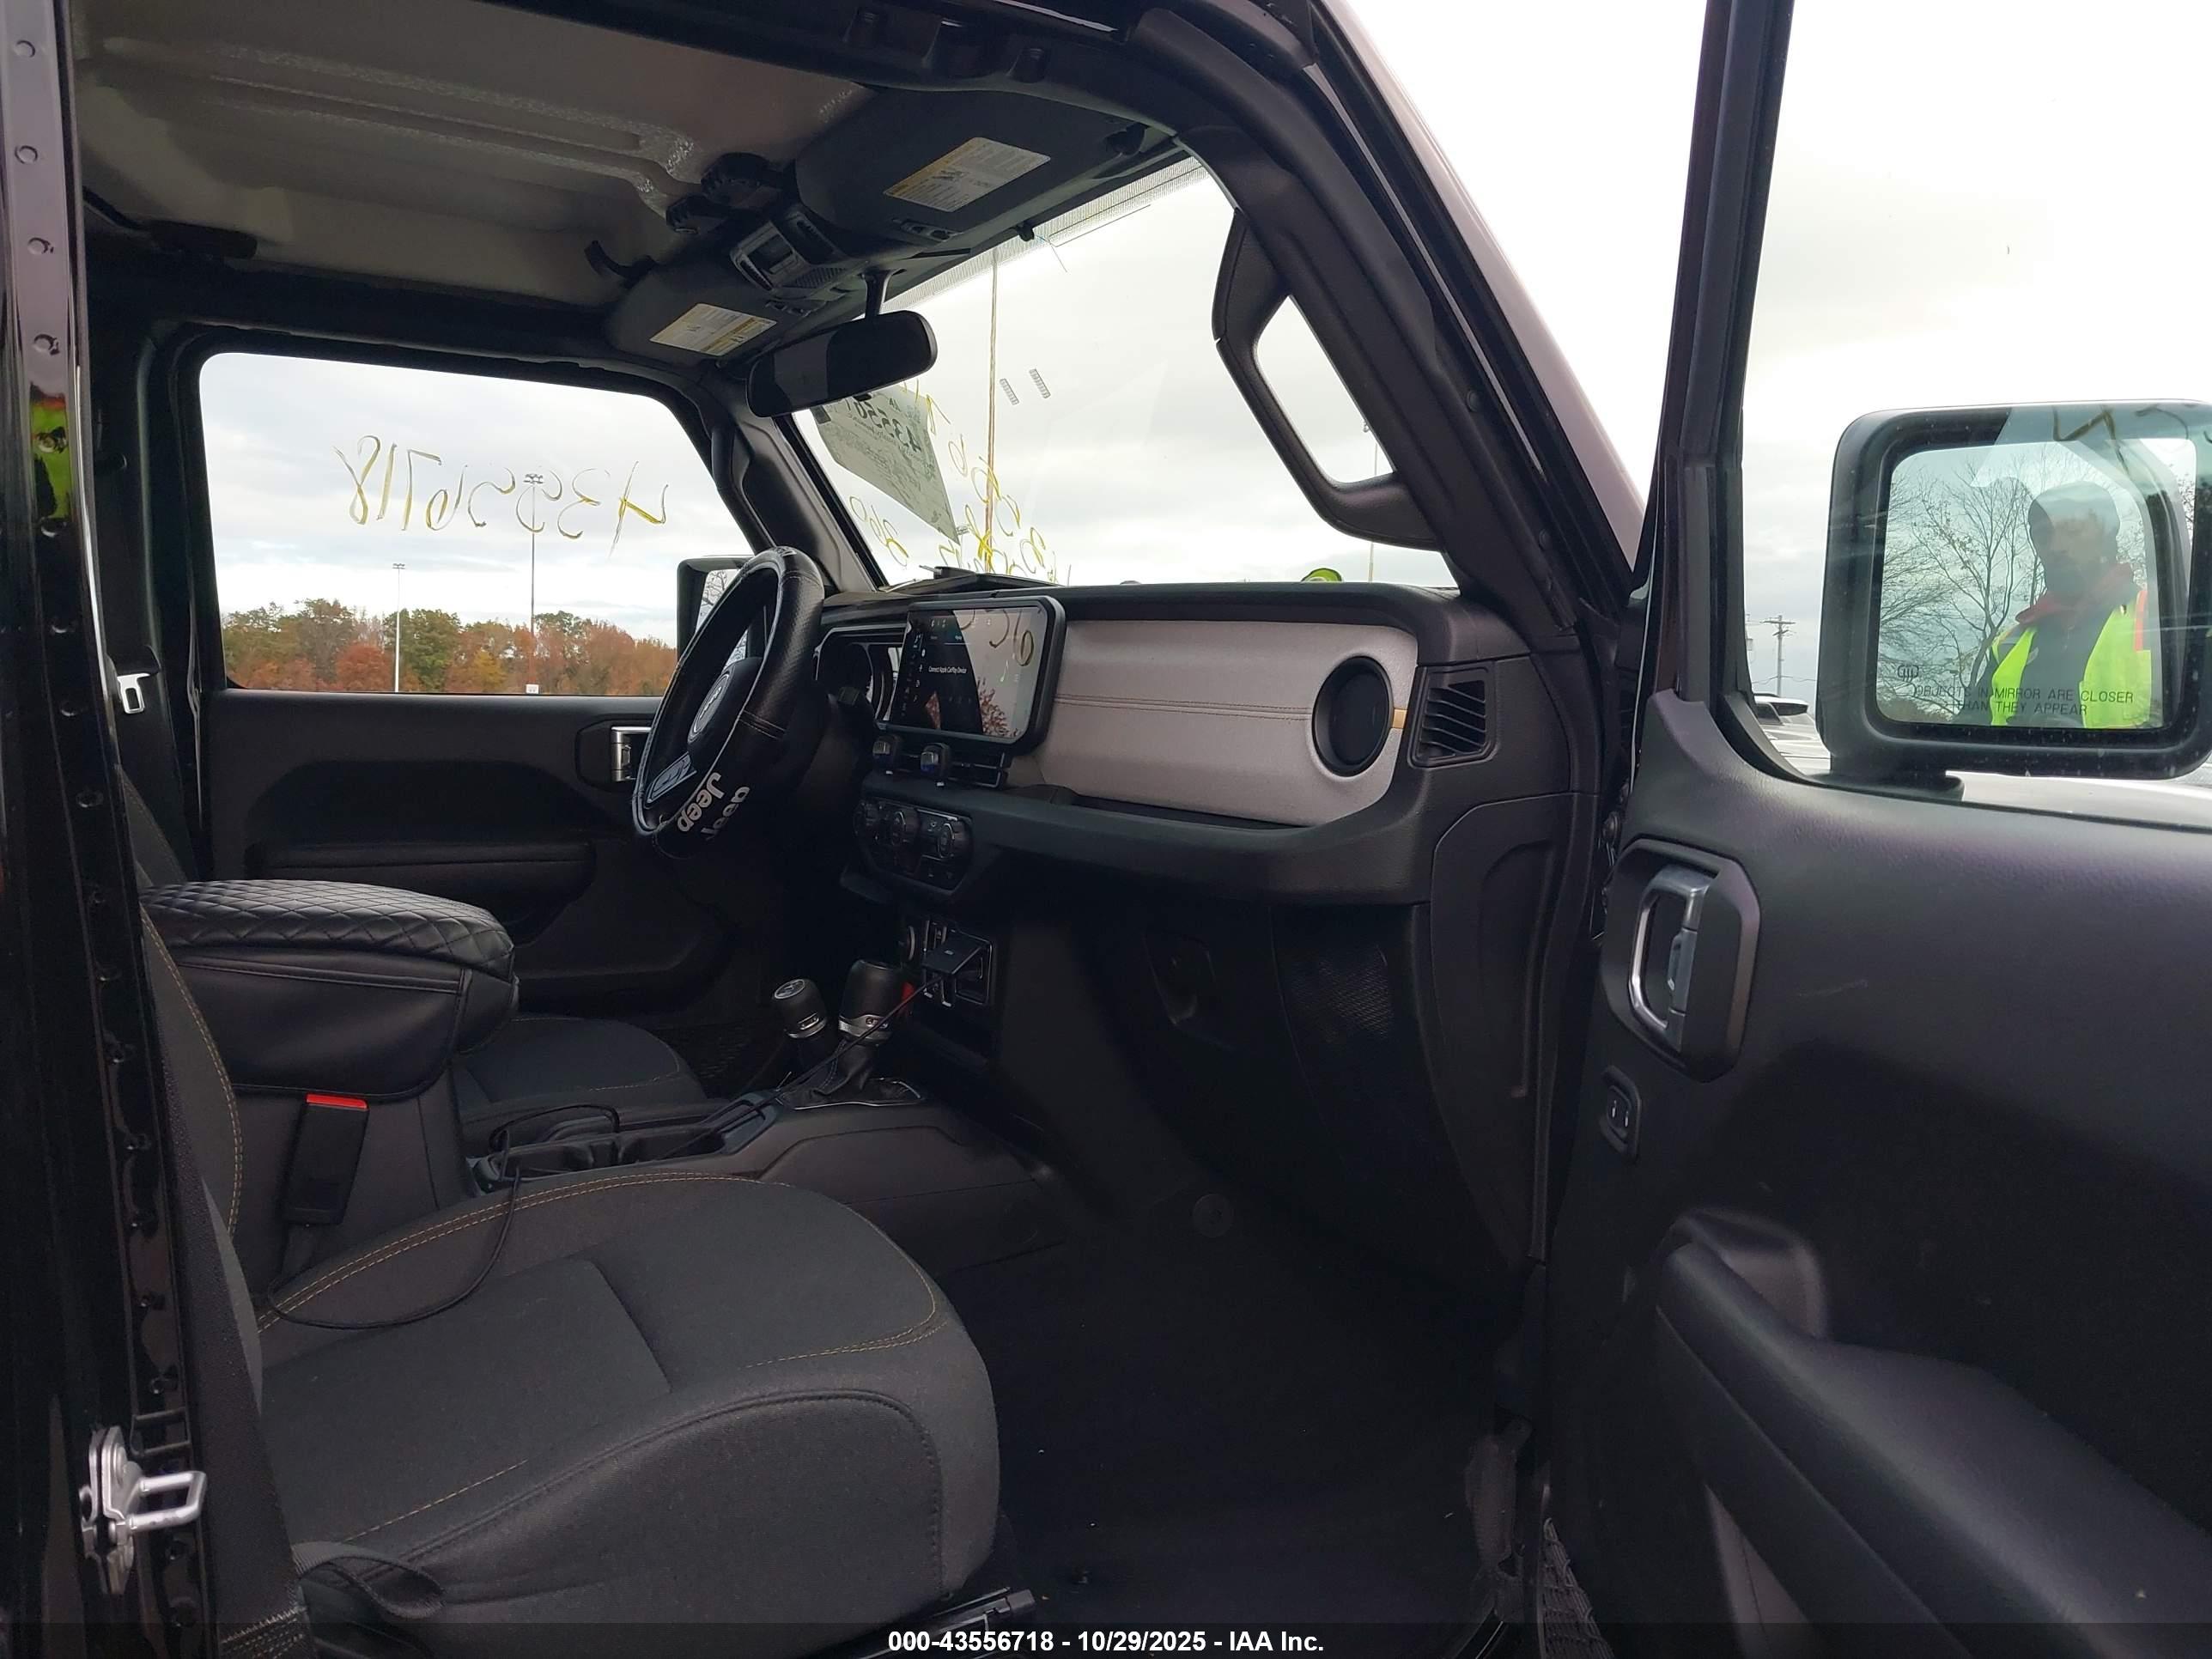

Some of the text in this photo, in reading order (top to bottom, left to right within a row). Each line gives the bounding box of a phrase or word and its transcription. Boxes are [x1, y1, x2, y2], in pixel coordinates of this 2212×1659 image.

[1978, 688, 1989, 698] IN
[1995, 688, 2041, 700] MIRROR
[2047, 689, 2075, 702] ARE
[2081, 690, 2134, 703] CLOSER
[1996, 701, 2027, 713] THEY
[2033, 702, 2087, 715] APPEAR
[677, 771, 726, 833] Jeep
